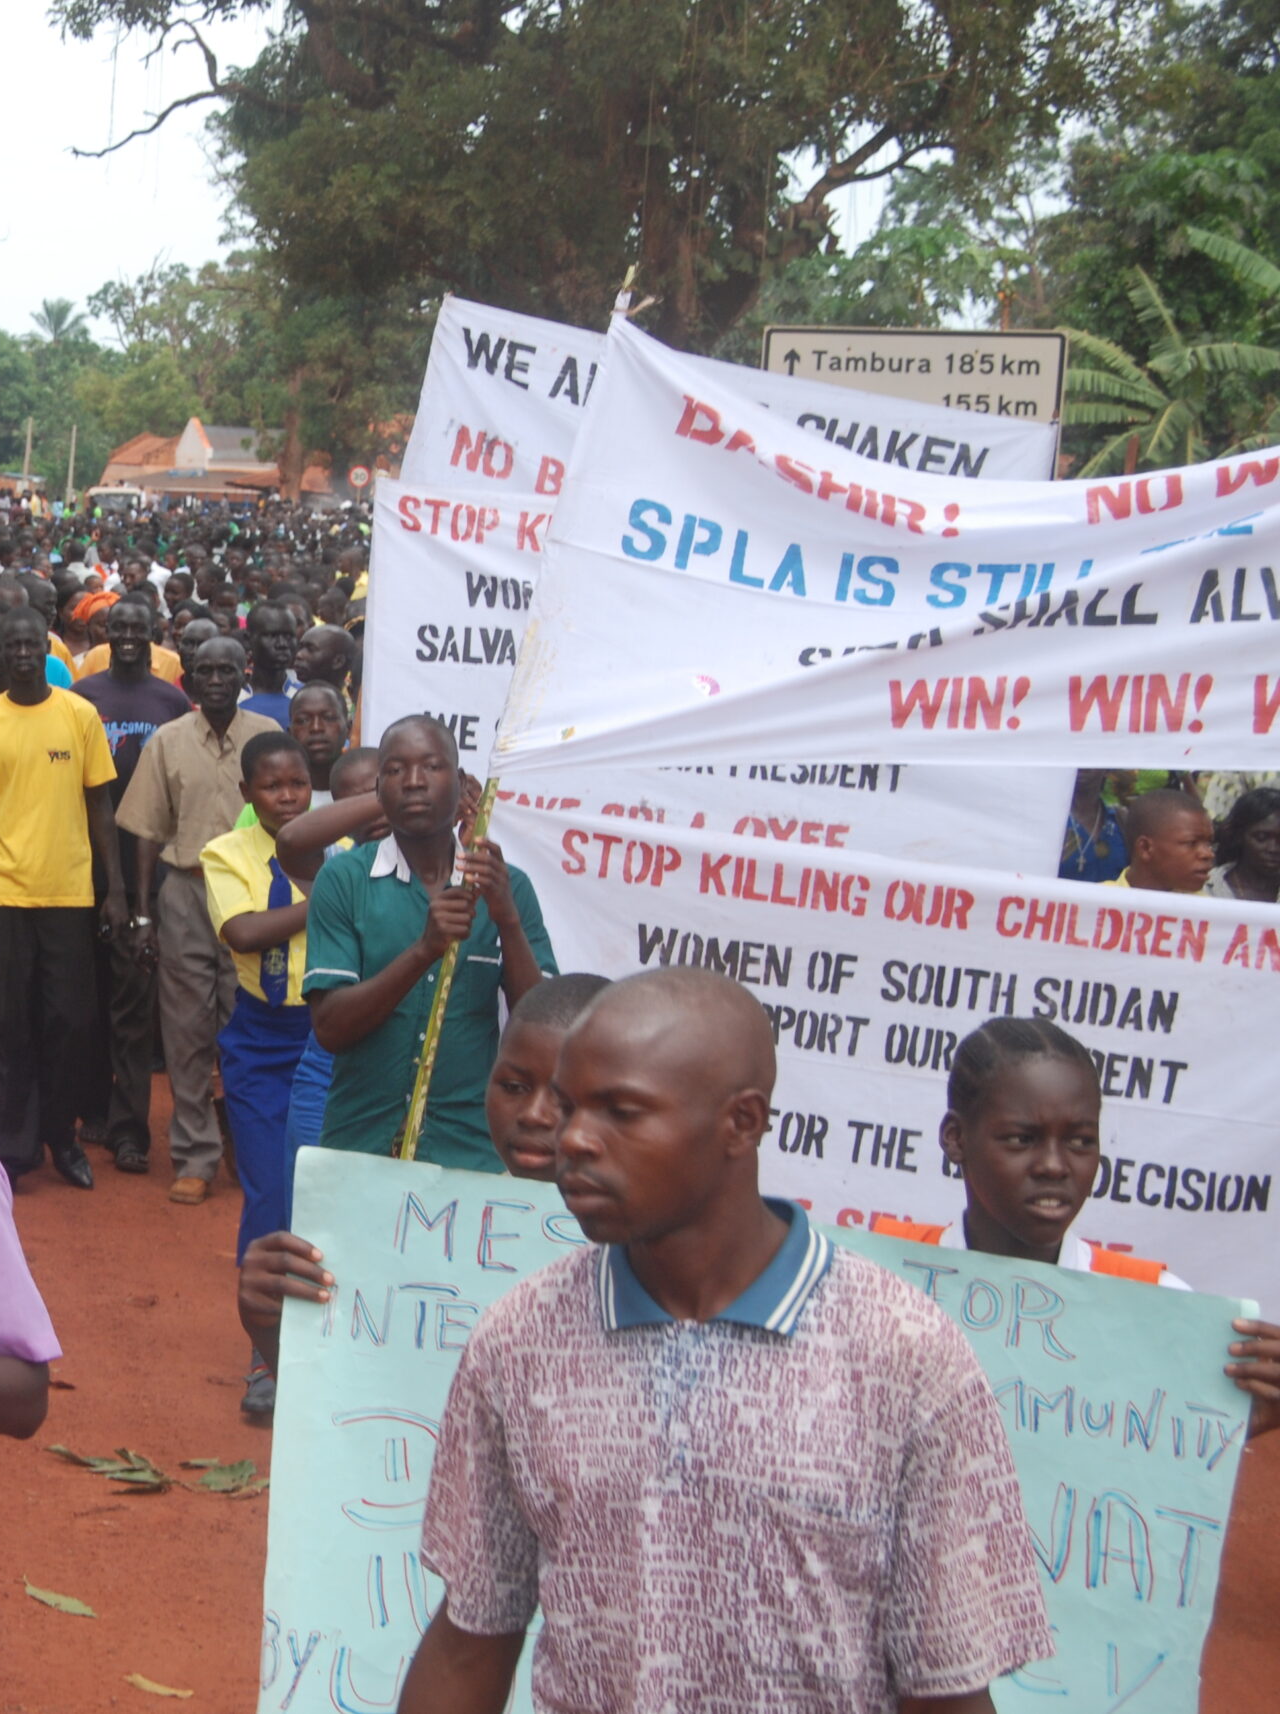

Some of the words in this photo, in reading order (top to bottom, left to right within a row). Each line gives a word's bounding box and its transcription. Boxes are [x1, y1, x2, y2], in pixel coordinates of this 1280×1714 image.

[463, 327, 536, 390] WE
[811, 350, 932, 374] Tambura
[945, 353, 995, 375] 185
[1000, 354, 1041, 376] km
[943, 394, 990, 414] 155
[997, 395, 1038, 416] km
[451, 425, 514, 479] NO
[398, 495, 501, 544] STOP
[1086, 474, 1183, 525] NO
[621, 498, 807, 598] SPLA
[835, 553, 900, 606] IS
[888, 676, 1032, 730] WIN!
[1068, 673, 1214, 733] WIN!
[561, 829, 682, 887] STOP
[699, 852, 871, 916] KILLING
[883, 879, 975, 930] OUR
[996, 895, 1209, 963] CHILDREN
[638, 923, 793, 987] WOMEN
[807, 950, 859, 995] OF
[880, 959, 1018, 1014] SOUTH
[1031, 976, 1180, 1034] SUDAN
[885, 1023, 958, 1072] OUR
[847, 1120, 923, 1173] THE
[1086, 1155, 1272, 1212] DECISION
